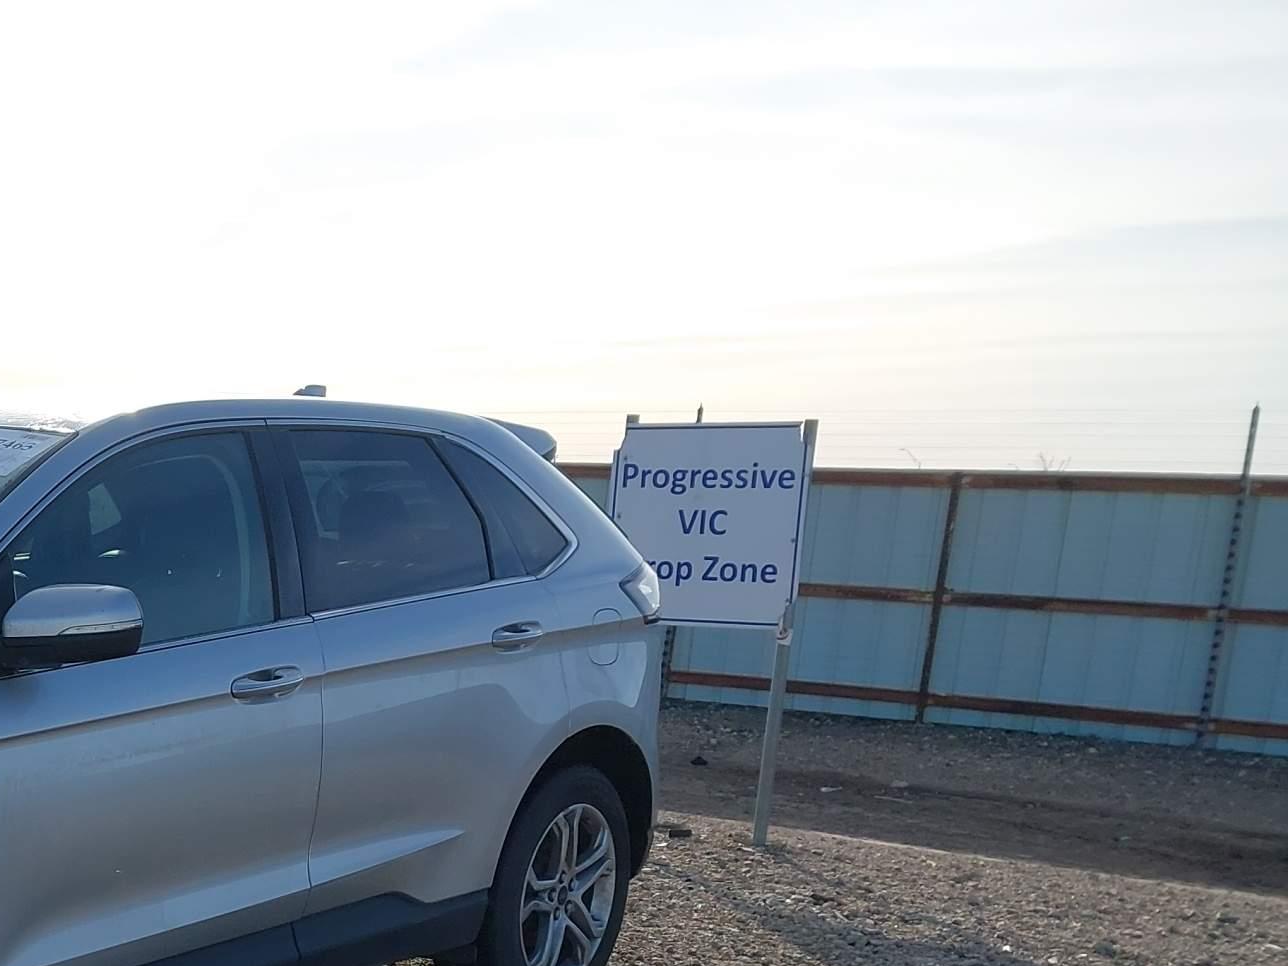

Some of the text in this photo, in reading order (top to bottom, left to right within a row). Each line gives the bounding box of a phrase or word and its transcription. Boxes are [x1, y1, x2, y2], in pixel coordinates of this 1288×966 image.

[622, 462, 796, 495] Progressive
[678, 509, 729, 535] VIC
[646, 556, 778, 587] op Zone
